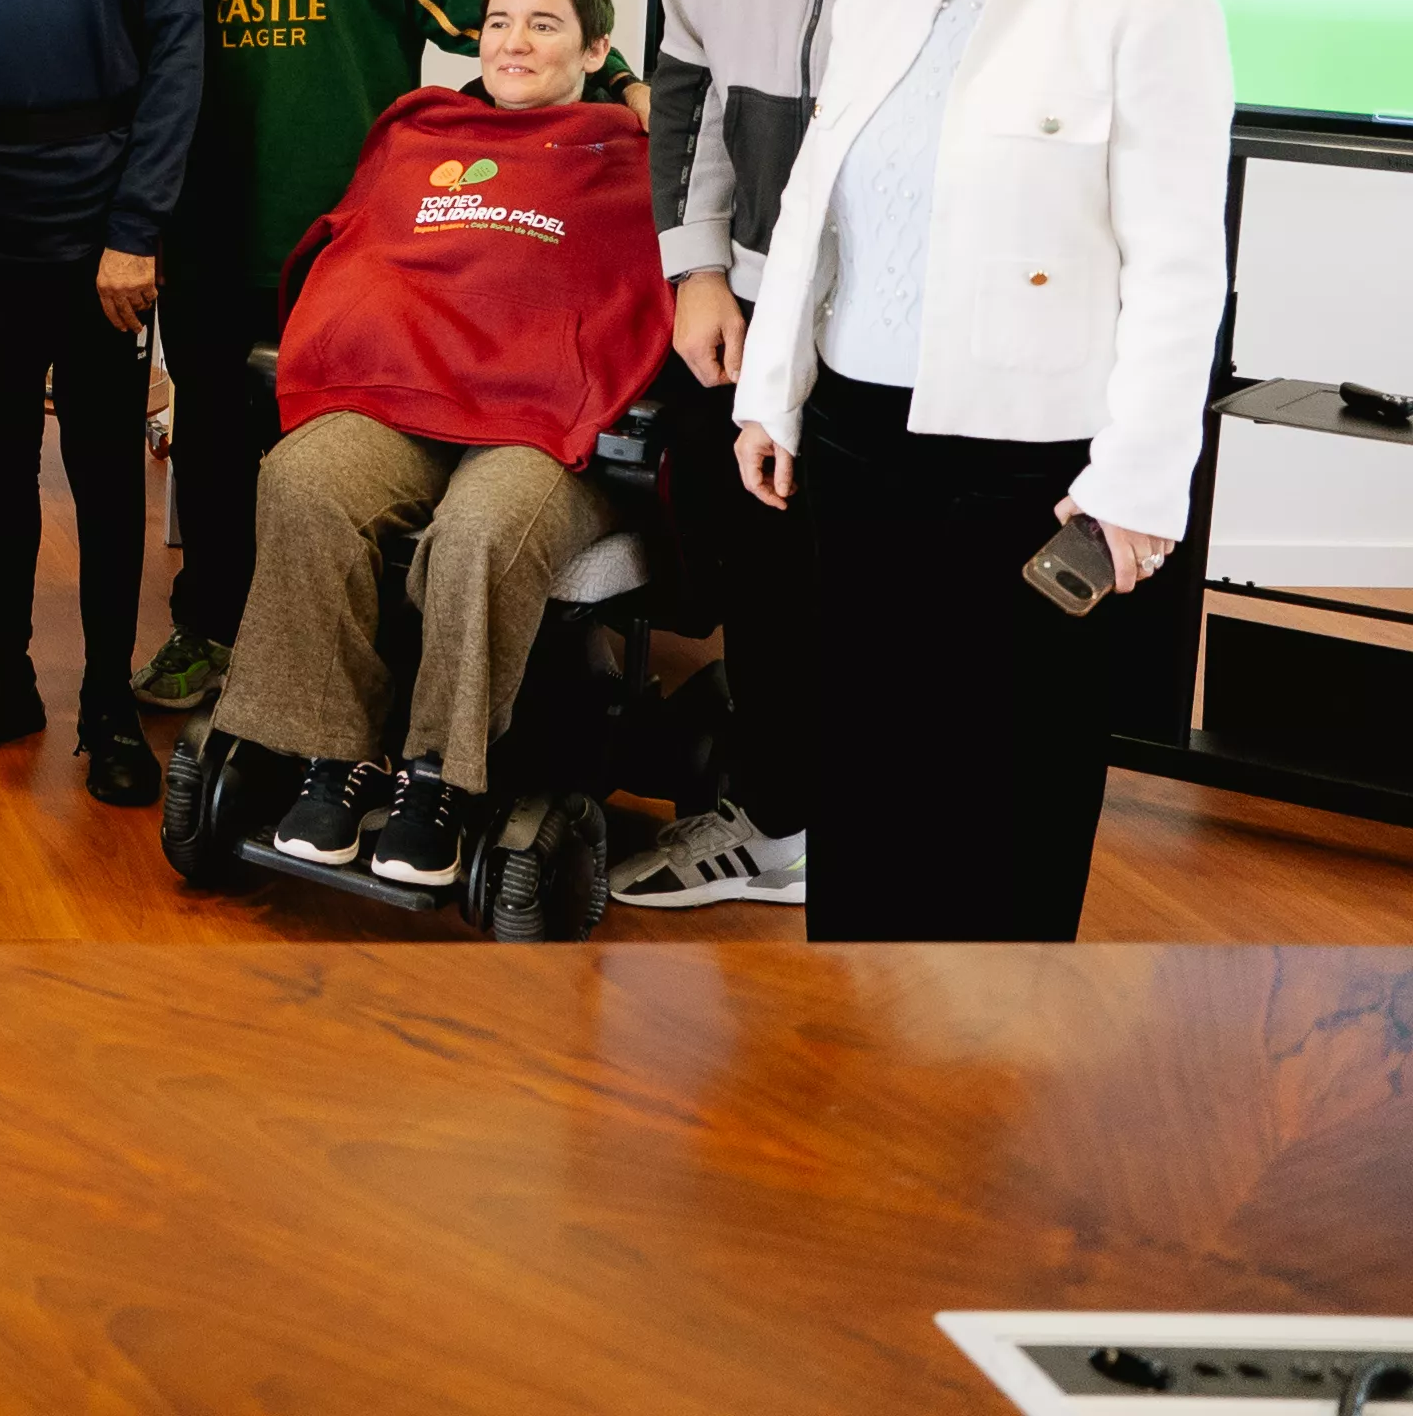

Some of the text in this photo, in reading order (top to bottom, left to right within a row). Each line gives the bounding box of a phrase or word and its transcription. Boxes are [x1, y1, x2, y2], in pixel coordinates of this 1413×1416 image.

[223, 27, 307, 48] LAGER
[420, 194, 483, 209] TORNEO
[415, 207, 566, 236] SOLIDARIO PÁDEL
